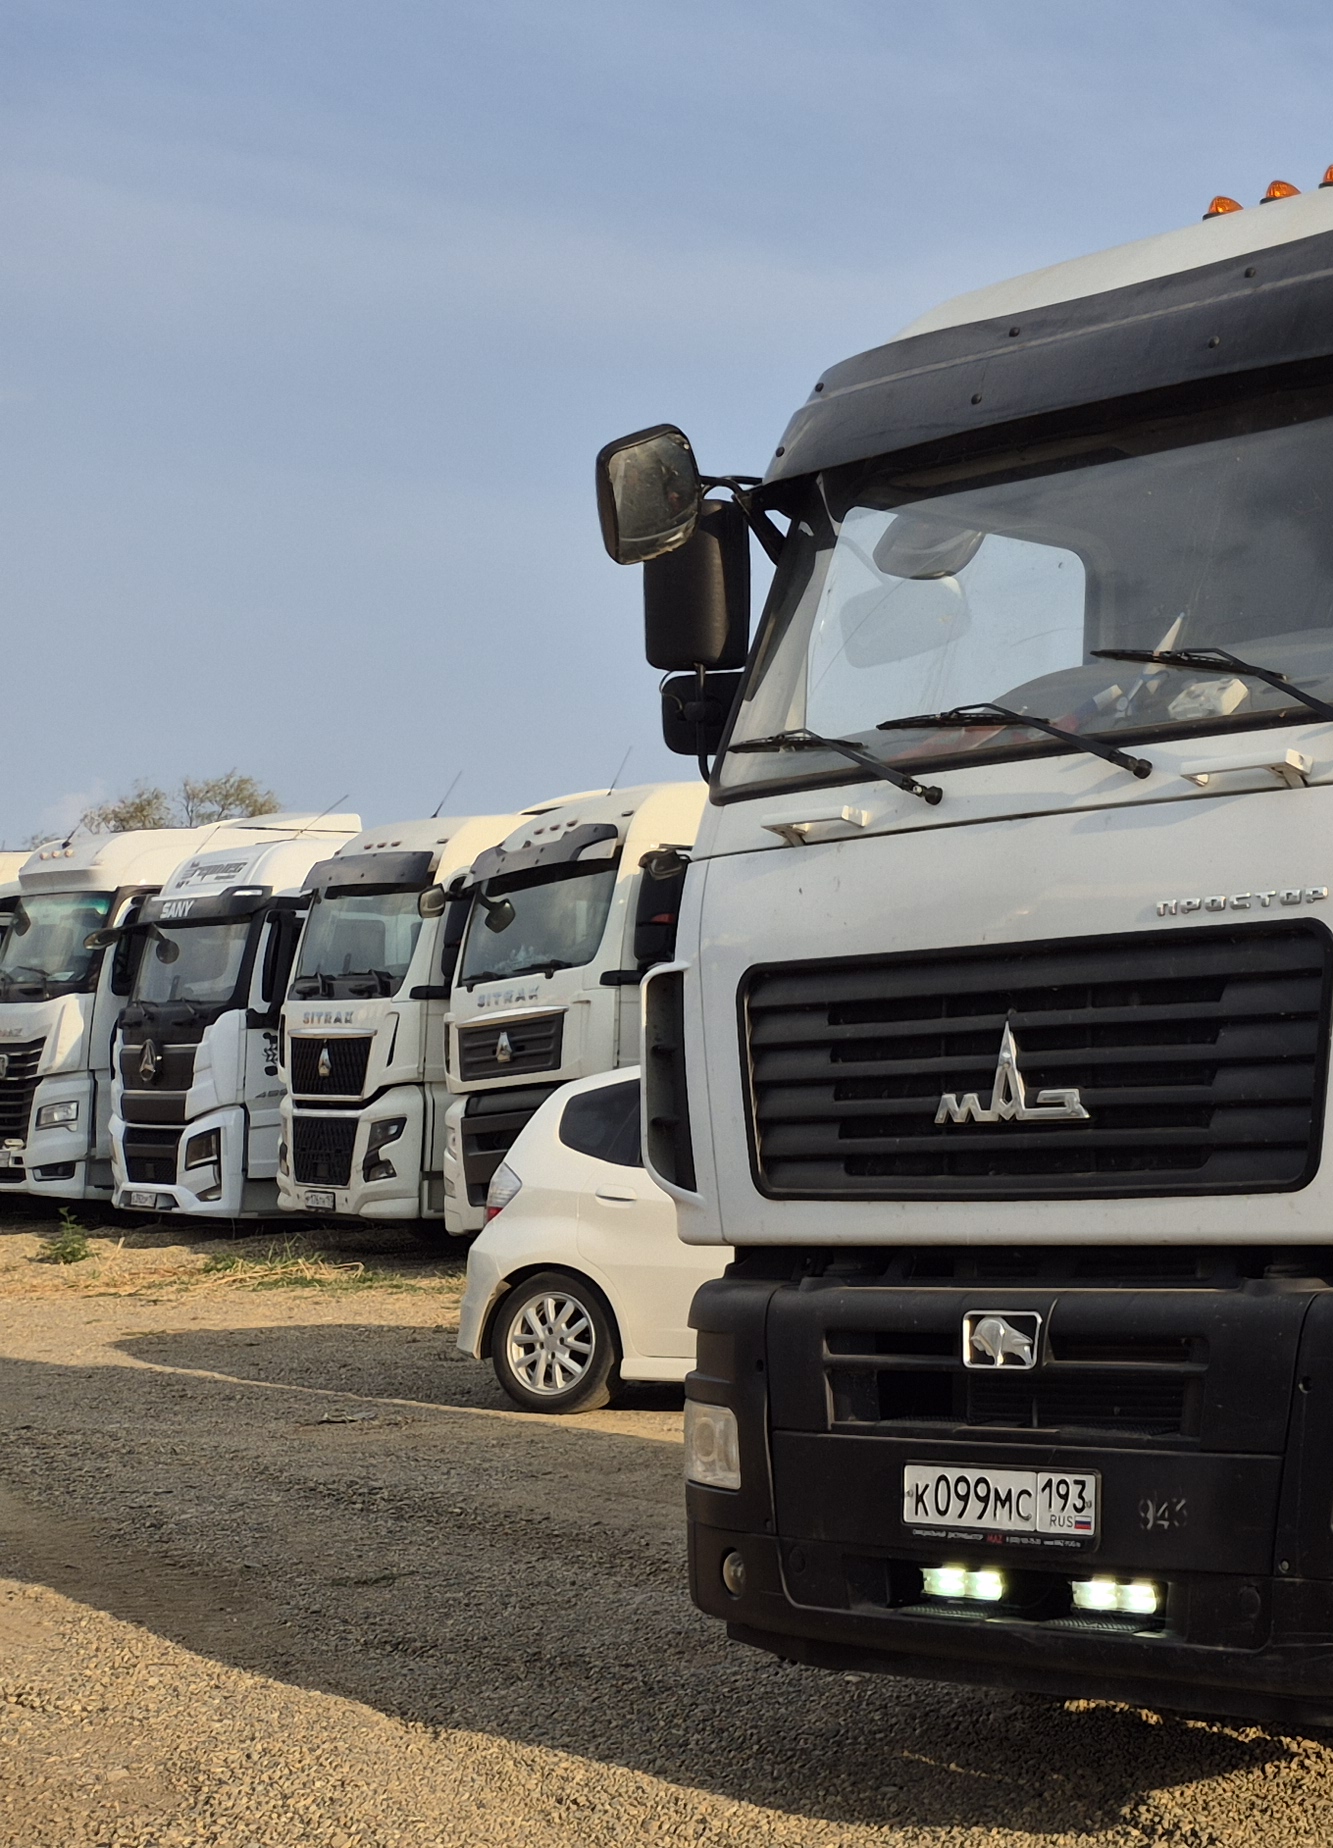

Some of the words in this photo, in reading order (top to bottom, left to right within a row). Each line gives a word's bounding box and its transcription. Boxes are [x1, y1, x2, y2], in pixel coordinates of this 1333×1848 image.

[160, 899, 195, 919] SANY
[1156, 886, 1329, 917] ПРОСТОР
[477, 985, 541, 1008] SITRAK
[303, 1011, 354, 1024] SITRAK
[934, 1021, 1091, 1123] МАЗ
[914, 1474, 1033, 1521] К099МС
[1041, 1477, 1088, 1514] 193
[1050, 1514, 1073, 1528] RUS
